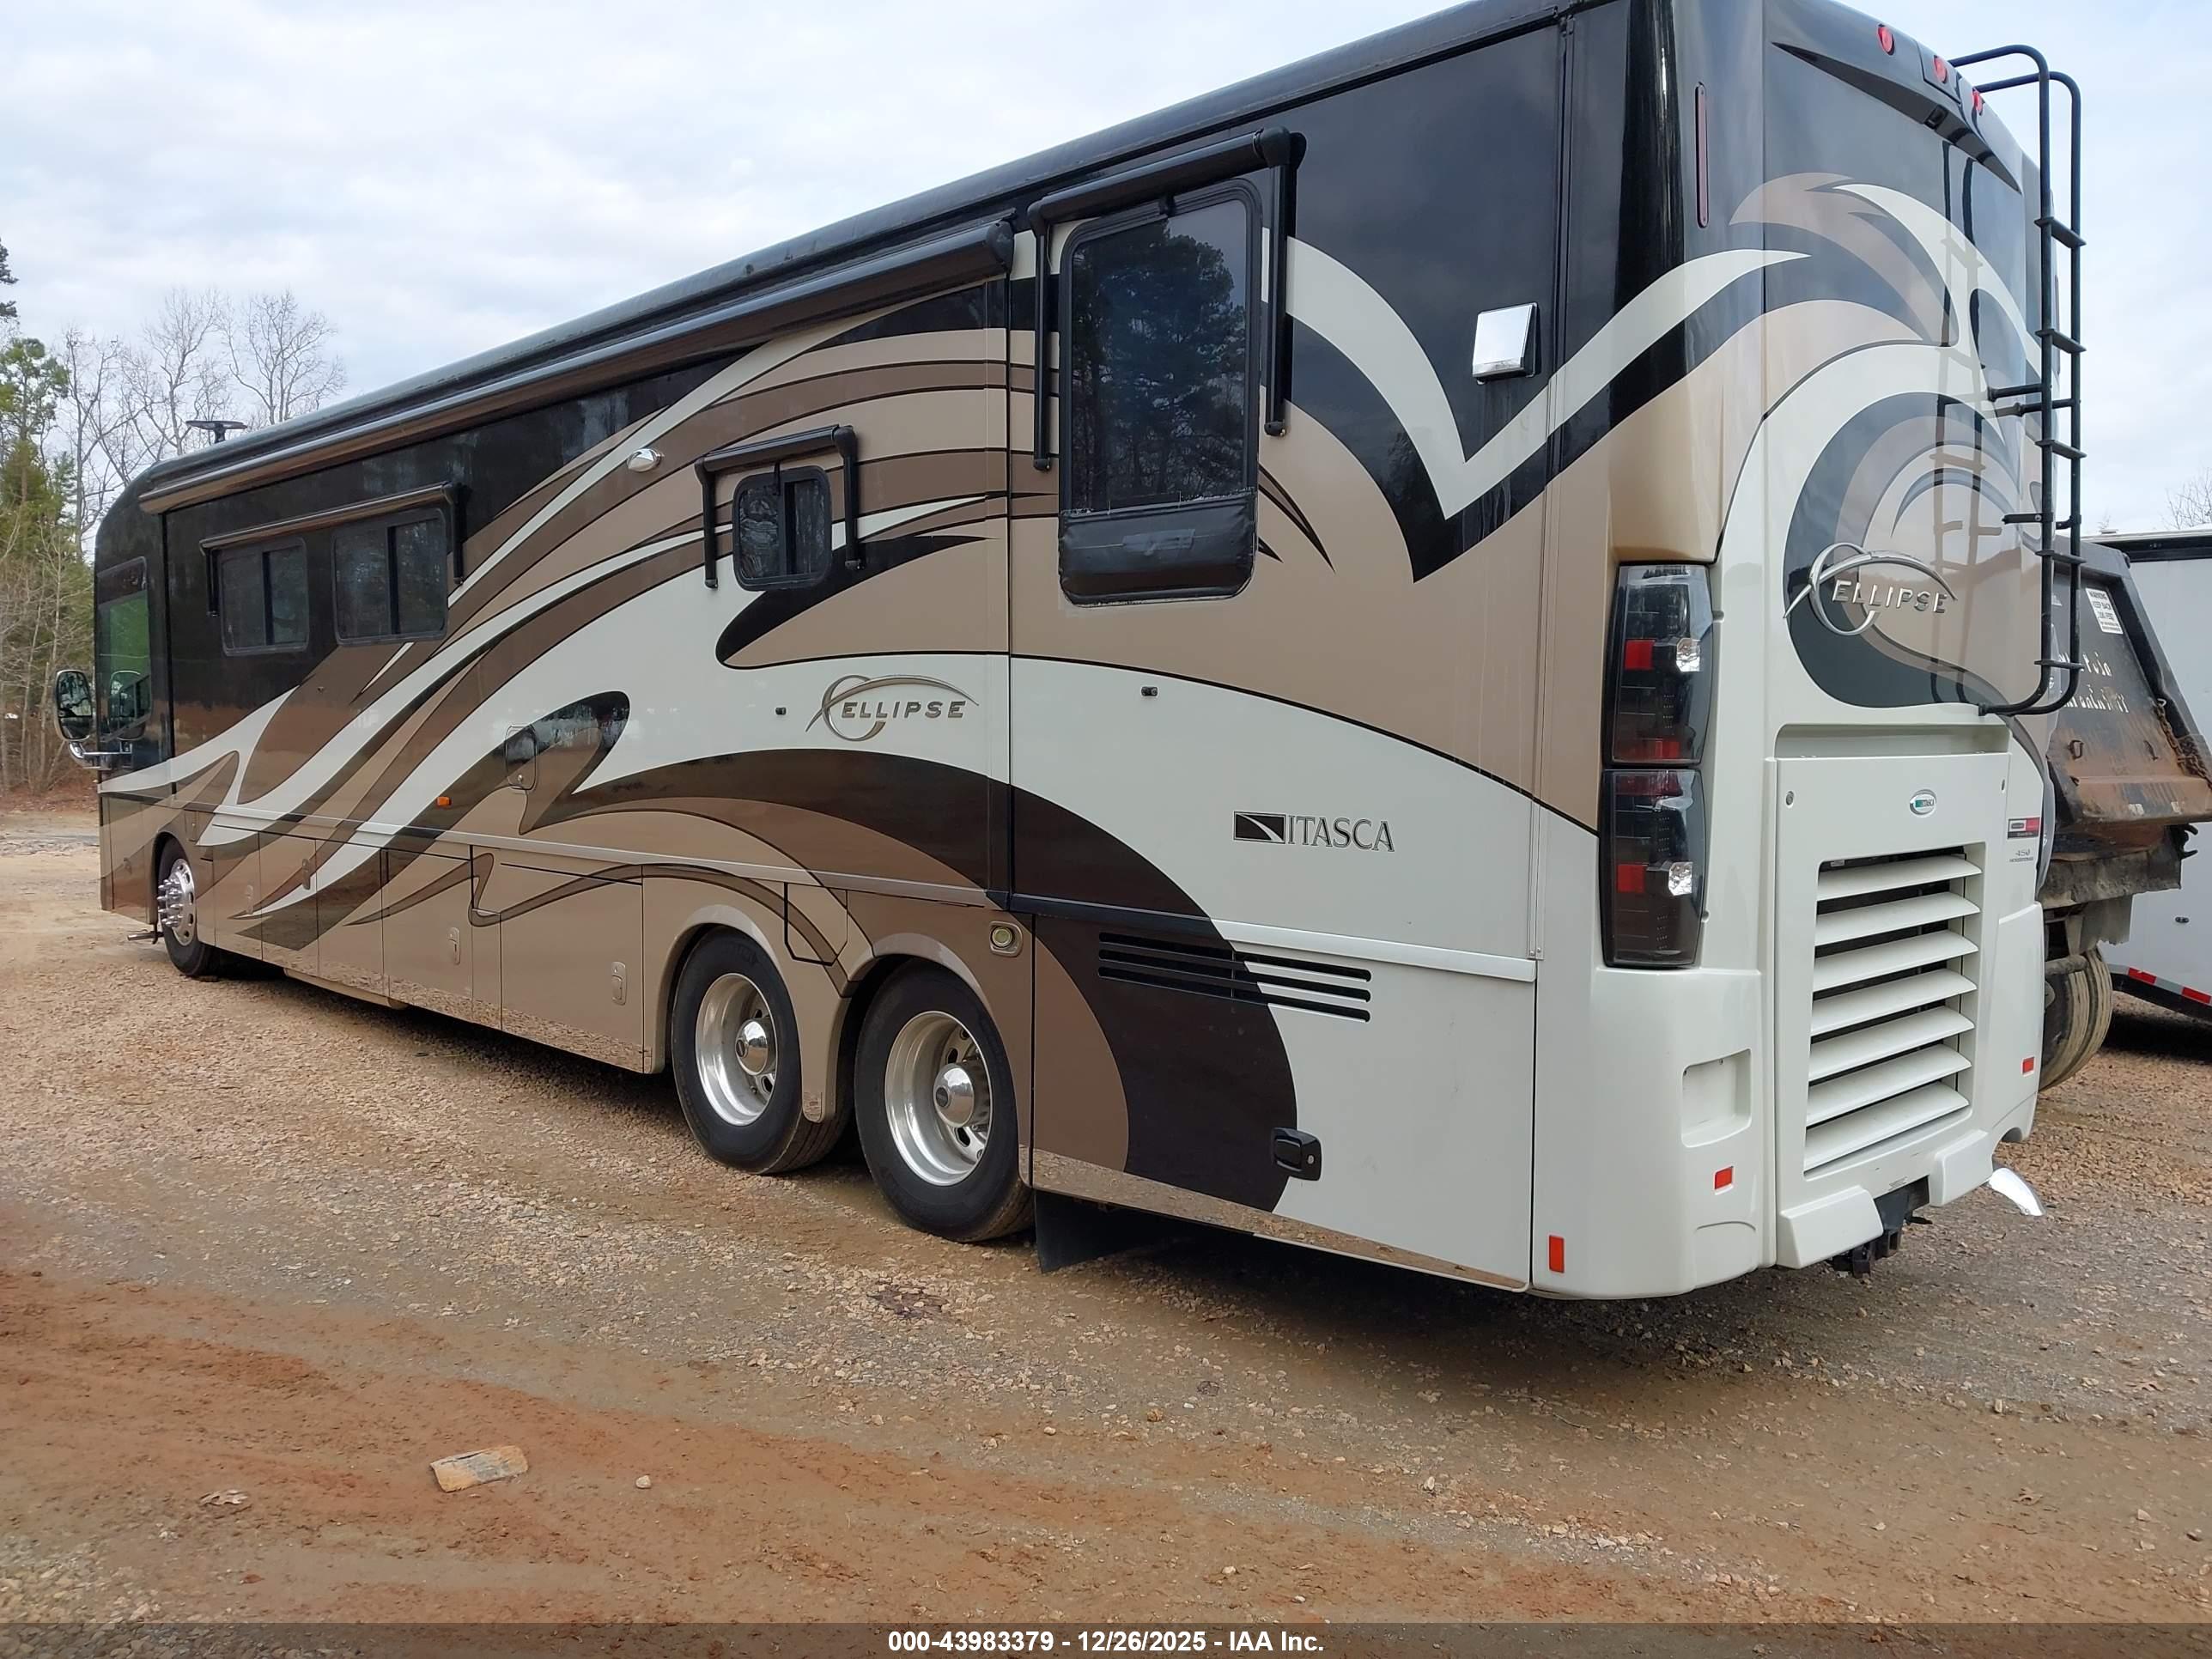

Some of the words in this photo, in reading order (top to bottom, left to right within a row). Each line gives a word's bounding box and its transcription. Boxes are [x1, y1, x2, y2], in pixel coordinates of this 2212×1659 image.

[1832, 579, 1948, 614] ELLIPSE
[841, 700, 967, 720] ELLIPSE
[1287, 815, 1395, 853] ITASCA
